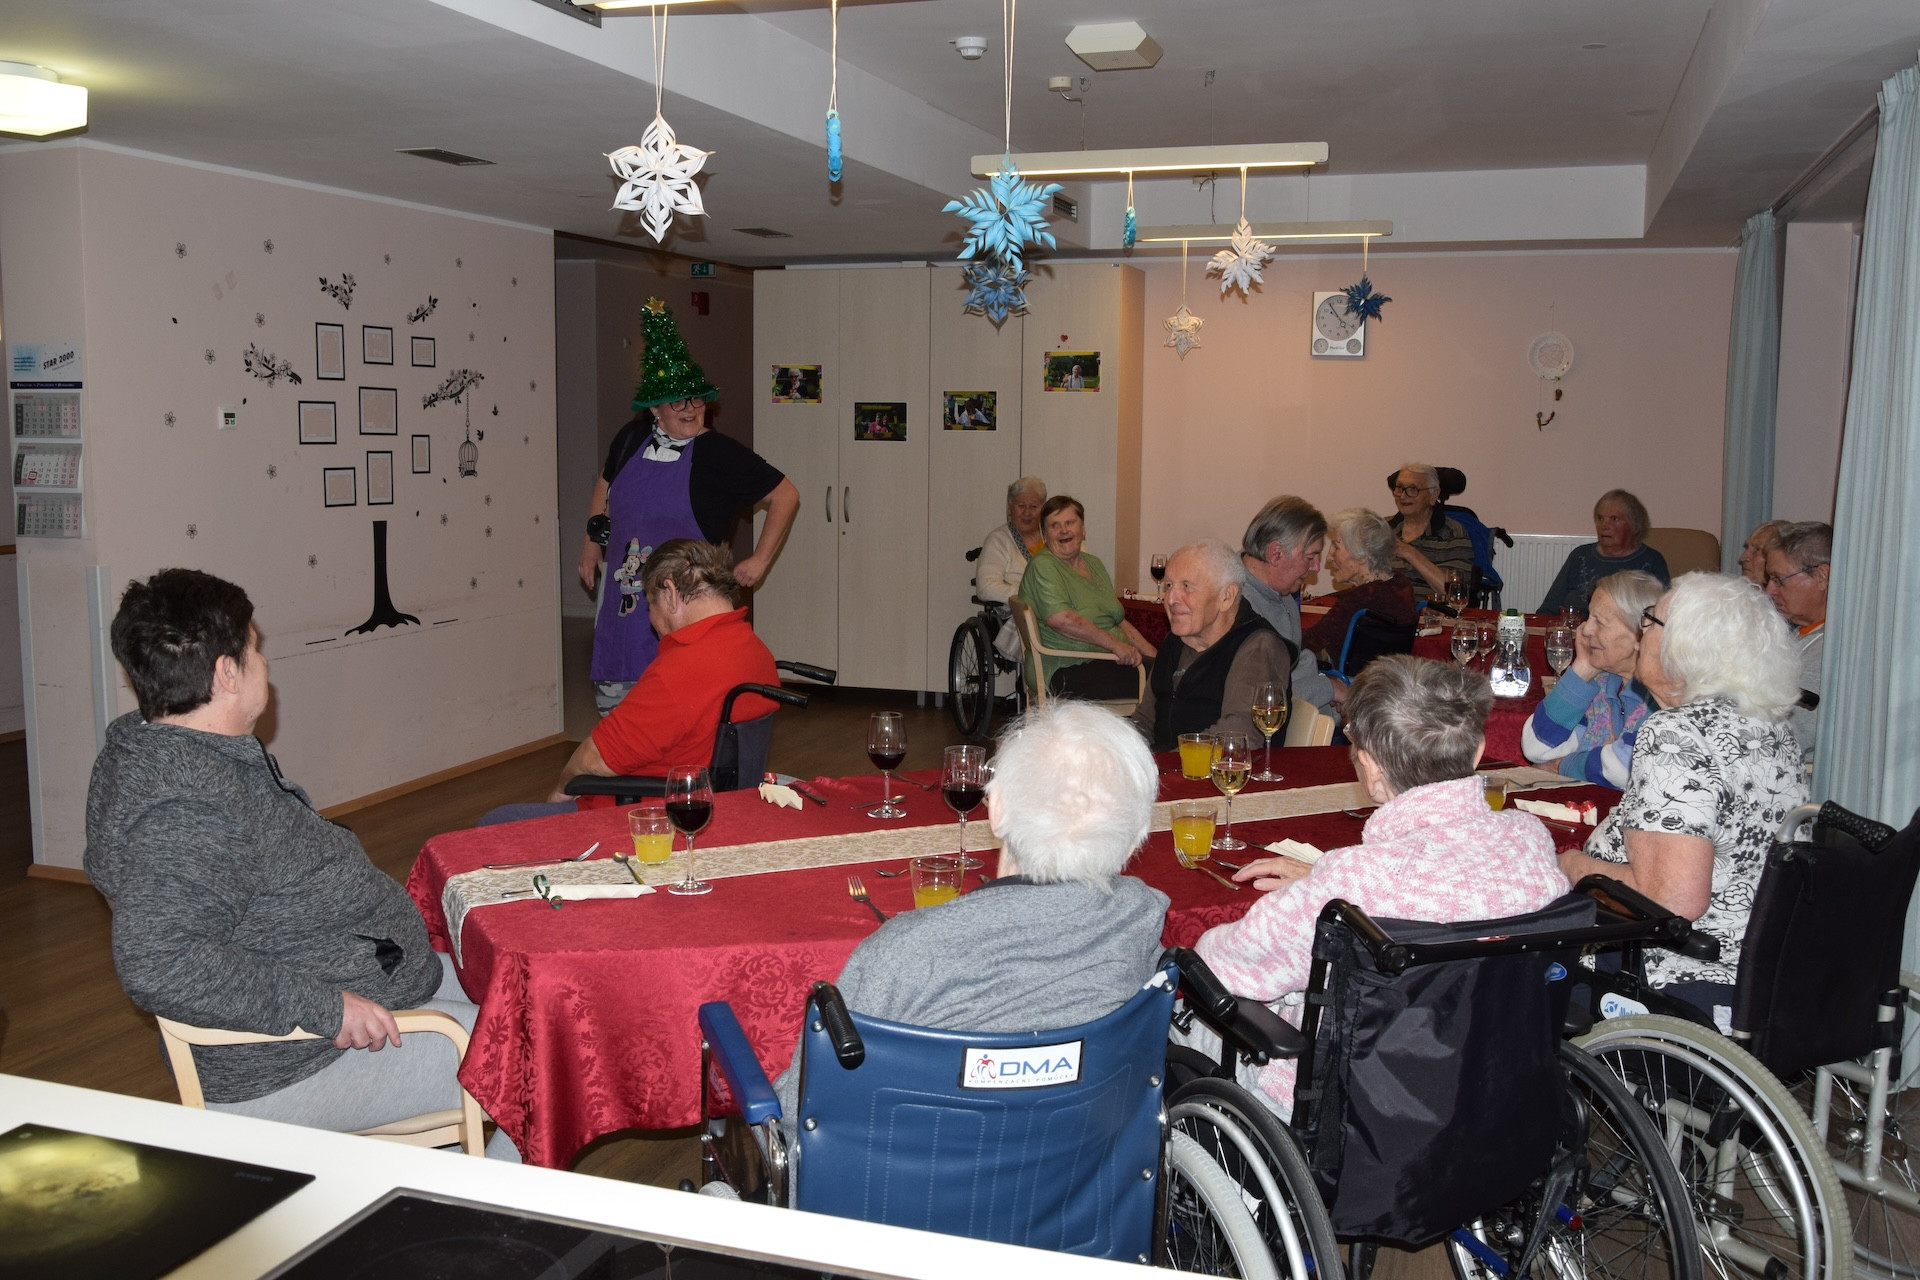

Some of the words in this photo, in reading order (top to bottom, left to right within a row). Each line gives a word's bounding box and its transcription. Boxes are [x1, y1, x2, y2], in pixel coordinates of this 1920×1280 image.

[43, 358, 57, 370] STAR
[58, 351, 74, 363] 2000
[1000, 1056, 1072, 1076] DMA
